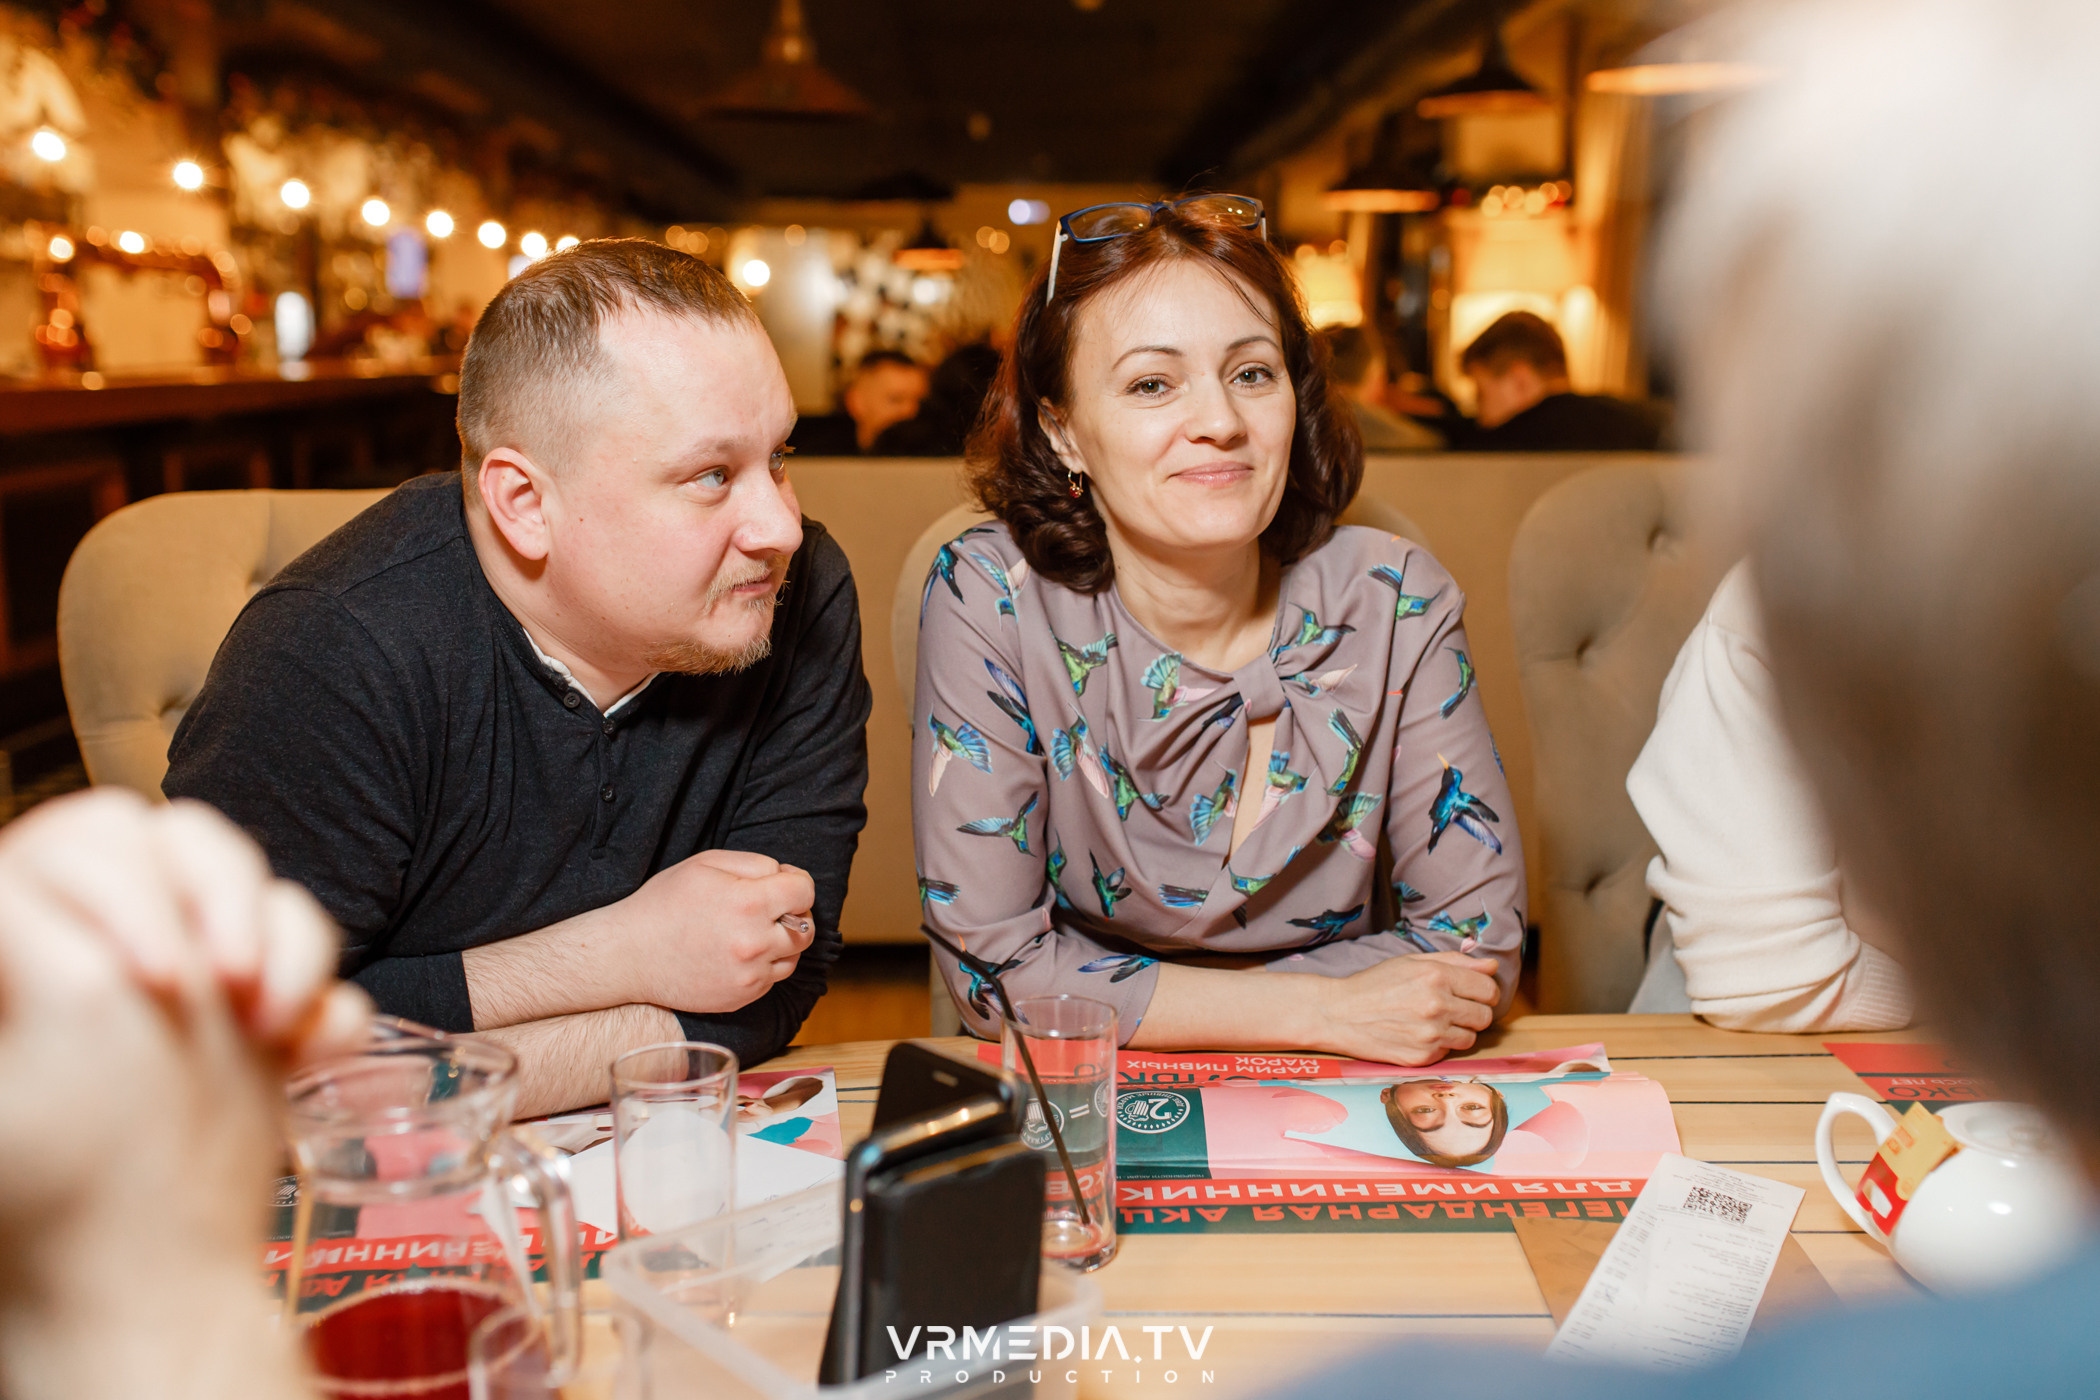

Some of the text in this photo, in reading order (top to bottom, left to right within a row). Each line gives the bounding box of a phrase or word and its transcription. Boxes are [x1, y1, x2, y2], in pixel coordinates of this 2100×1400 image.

[1126, 1060, 1320, 1074] ДАРИМ ПИВНЫХ
[1234, 1056, 1318, 1066] МАРОК
[1148, 1098, 1172, 1120] 2
[1512, 1180, 1632, 1195] ДЛЯ
